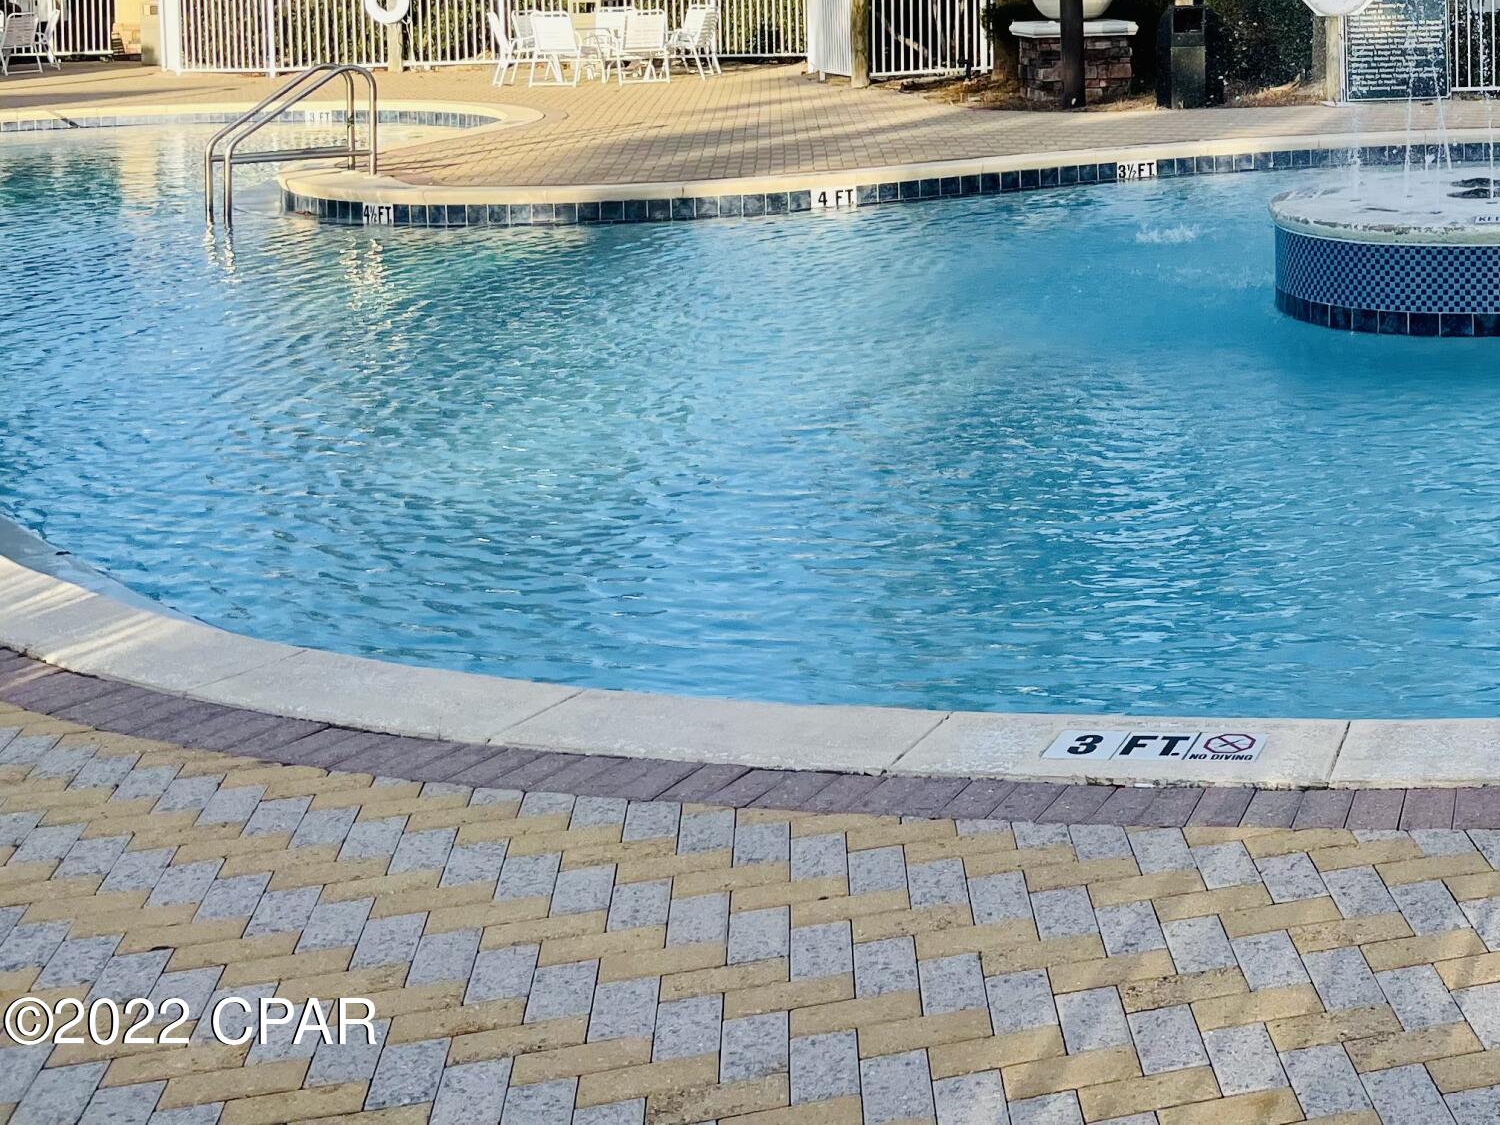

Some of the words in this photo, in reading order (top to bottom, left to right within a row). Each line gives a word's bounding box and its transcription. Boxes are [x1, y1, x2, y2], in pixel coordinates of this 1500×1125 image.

[818, 191, 828, 207] 4
[1066, 734, 1104, 755] 3
[1118, 735, 1191, 756] FT.
[1210, 753, 1254, 761] DIVING
